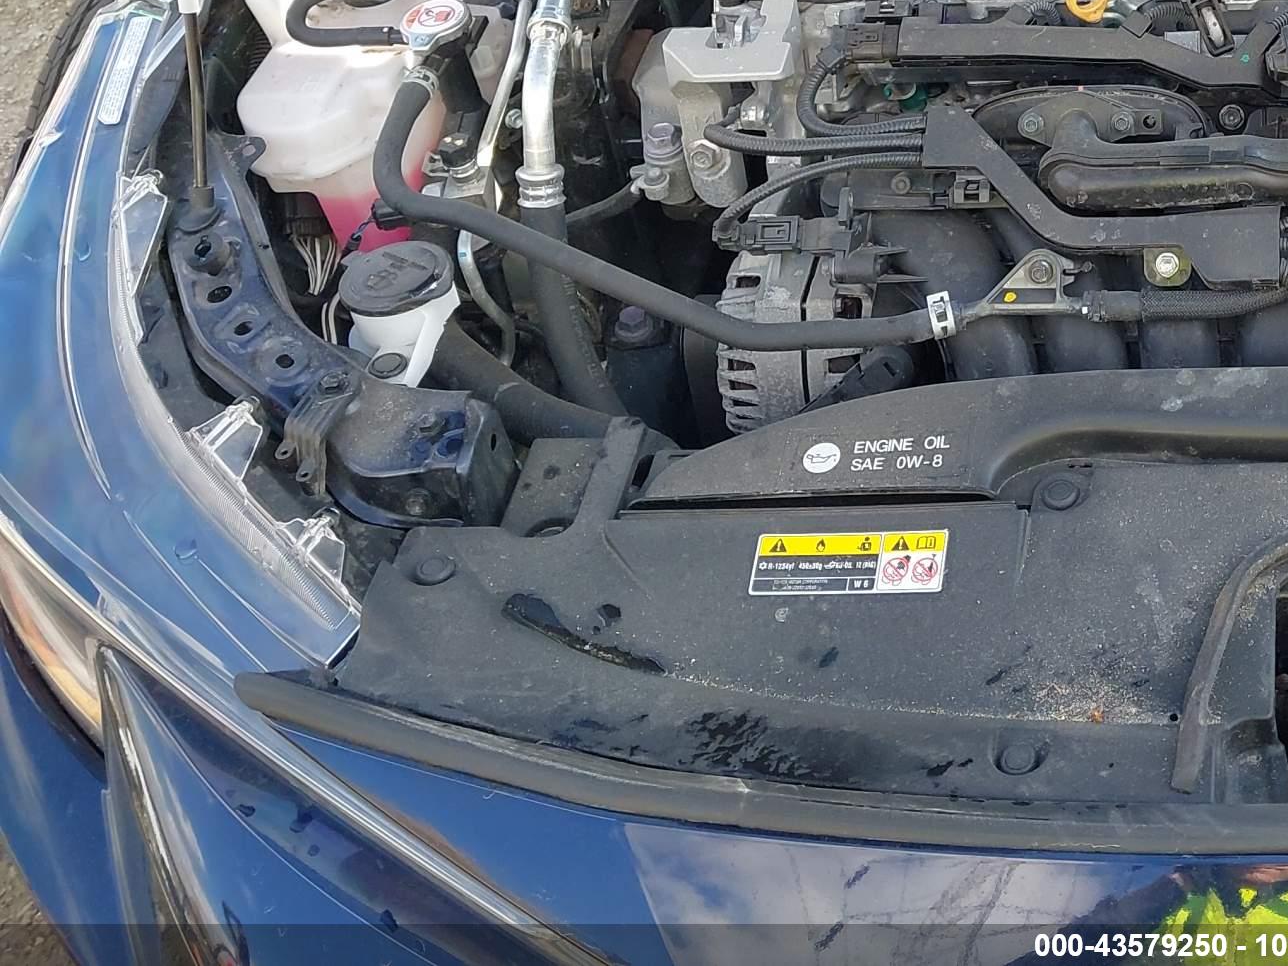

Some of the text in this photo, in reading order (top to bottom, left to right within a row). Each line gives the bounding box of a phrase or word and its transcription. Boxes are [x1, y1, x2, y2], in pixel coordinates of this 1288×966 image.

[853, 435, 950, 454] ENGINE OIL
[850, 454, 943, 471] SAE 0W-8
